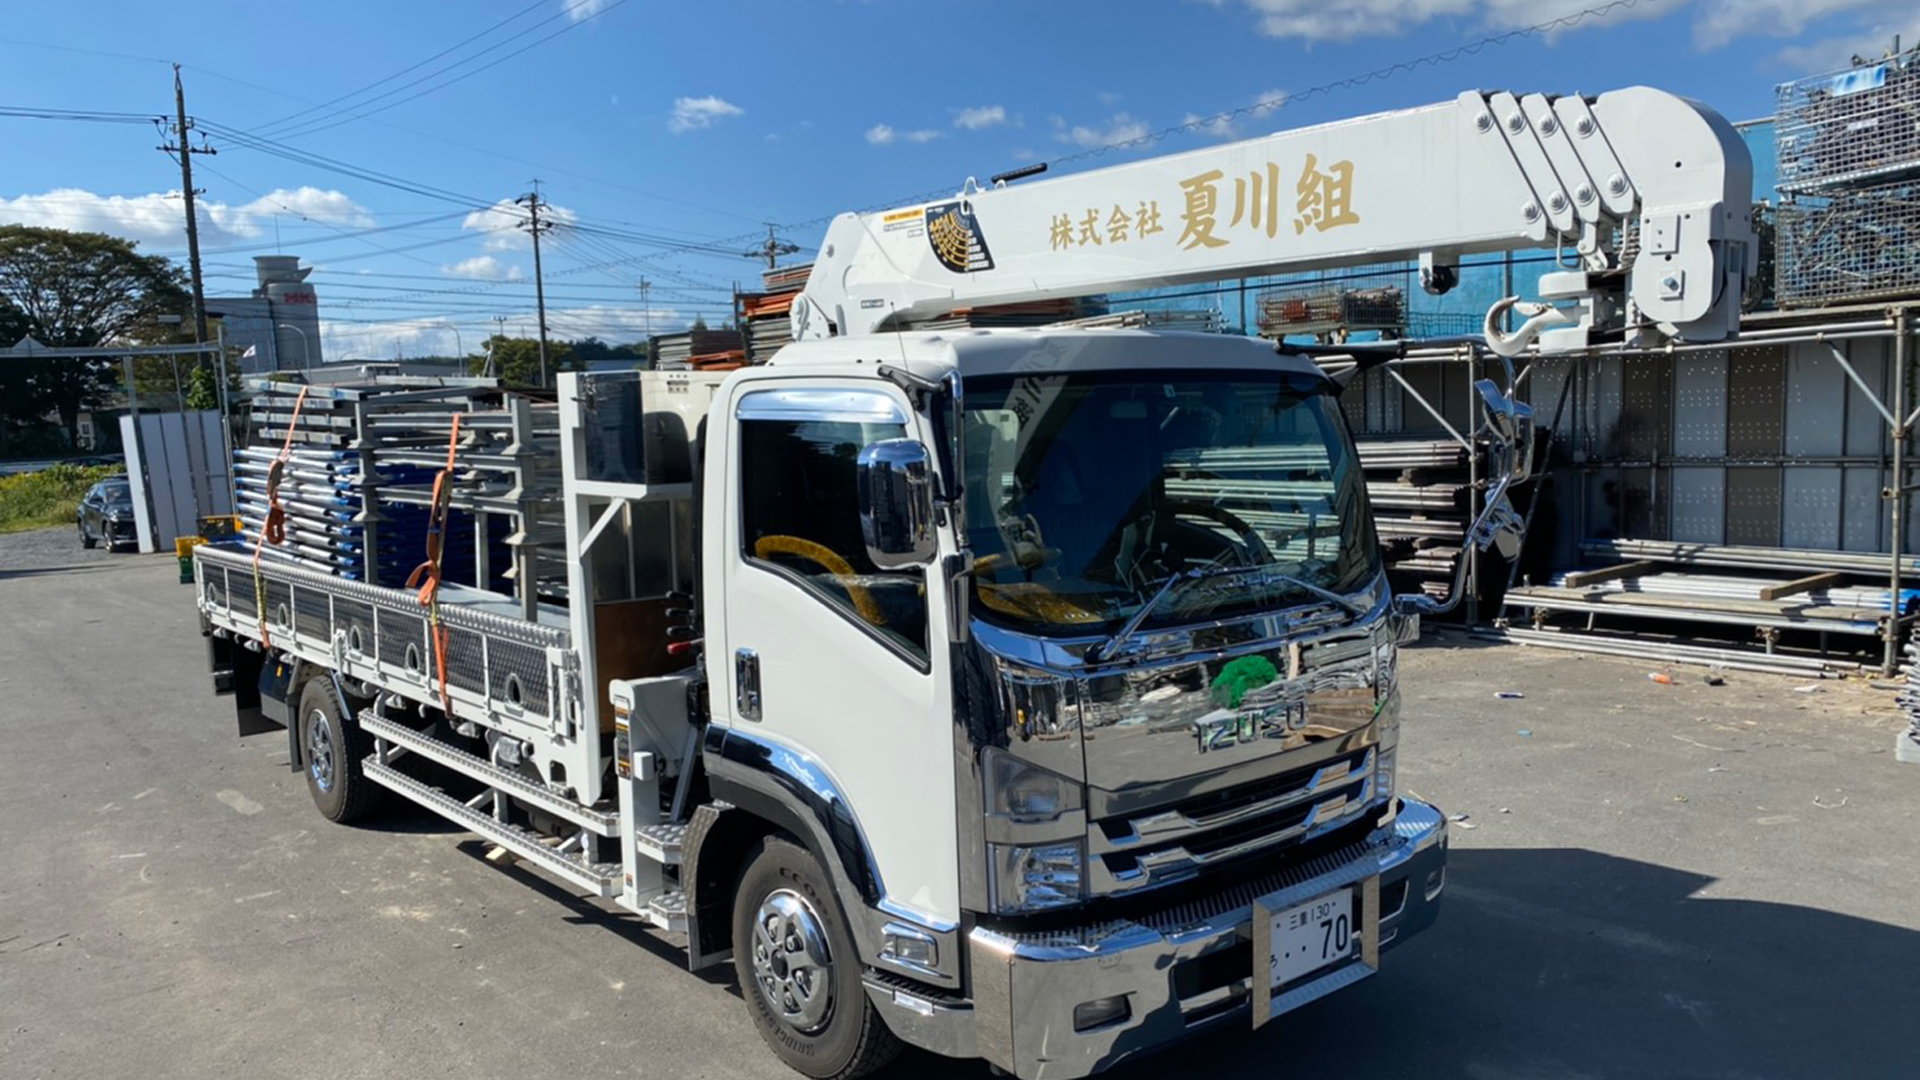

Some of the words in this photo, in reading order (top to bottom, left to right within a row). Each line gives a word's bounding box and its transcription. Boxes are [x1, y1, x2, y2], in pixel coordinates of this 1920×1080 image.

[1049, 200, 1164, 251] 株式会社
[1176, 153, 1361, 251] 夏川組
[1320, 913, 1348, 960] 70
